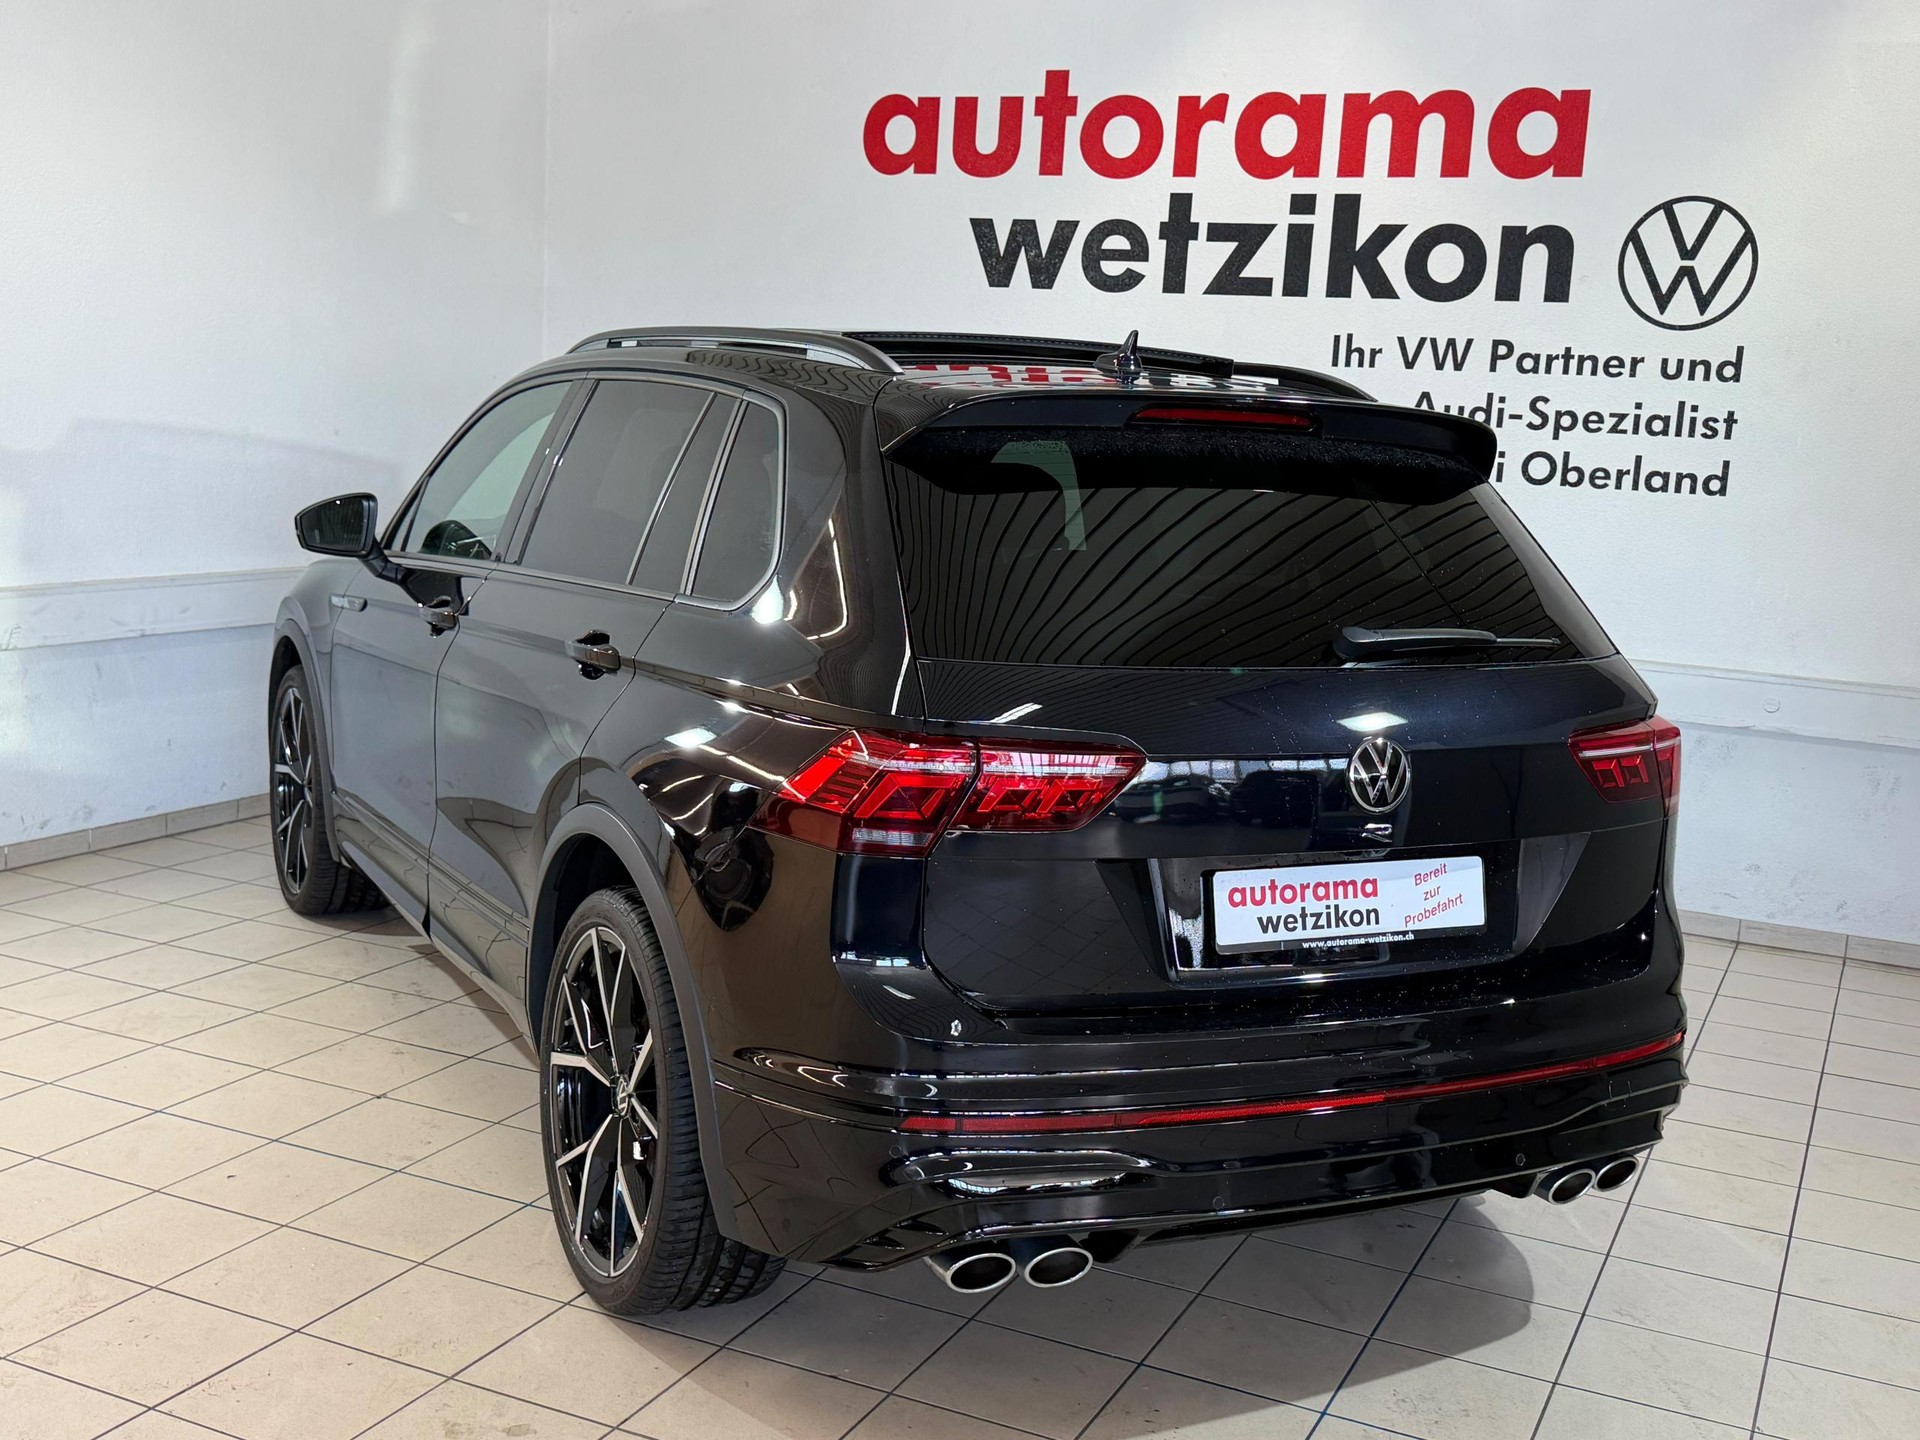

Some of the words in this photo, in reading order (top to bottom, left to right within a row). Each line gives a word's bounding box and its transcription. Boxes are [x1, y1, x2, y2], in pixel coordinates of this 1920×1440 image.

[863, 69, 1591, 181] autorama
[969, 192, 1575, 303] wetzikon
[1331, 333, 1383, 368] Ihr
[1397, 336, 1474, 371] VW
[1489, 339, 1645, 378] Partner
[1660, 345, 1745, 383] und
[1521, 450, 1731, 497] Oberland
[1413, 863, 1448, 887] Bereit
[1227, 877, 1379, 908] autorama
[1423, 884, 1441, 901] zur
[1257, 904, 1380, 934] wetzikon
[1404, 893, 1463, 927] Probefahrt
[1302, 931, 1415, 949] www.autorama-wetzikon.ch
